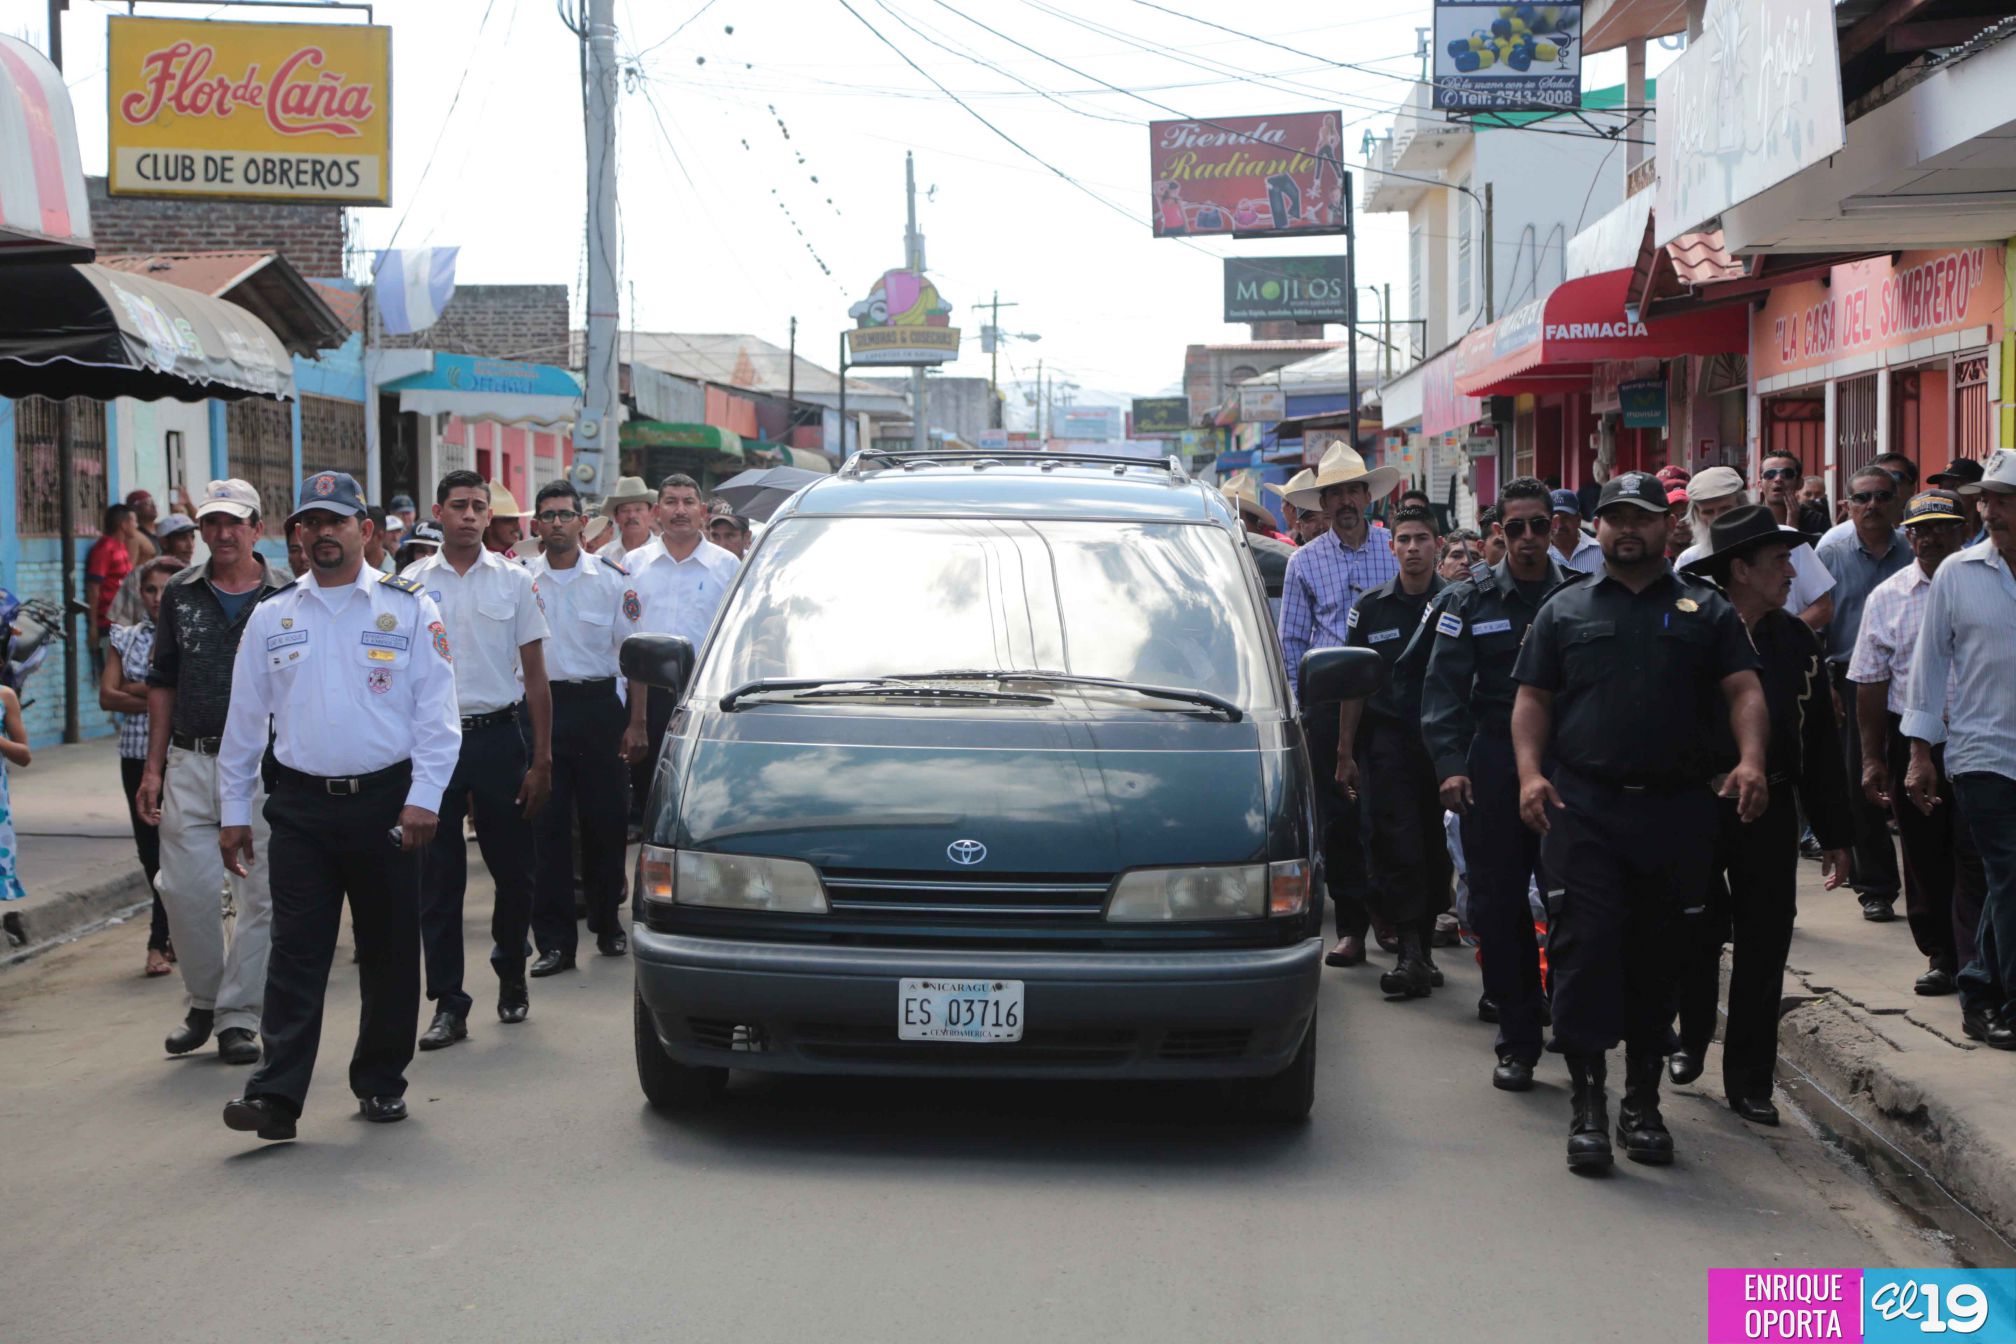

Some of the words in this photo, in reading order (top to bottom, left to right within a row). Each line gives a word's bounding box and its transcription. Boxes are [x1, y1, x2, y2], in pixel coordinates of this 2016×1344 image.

[121, 41, 233, 126] Flor
[231, 64, 264, 106] de
[265, 46, 374, 137] Caña
[1496, 89, 1574, 106] 2713-2008
[1160, 122, 1287, 149] Tienda
[136, 153, 196, 183] CLUB
[204, 155, 234, 184] DE
[244, 158, 360, 190] OBREROS
[1160, 146, 1316, 181] Radiante
[1545, 321, 1649, 340] FARMACIA
[1804, 299, 1837, 358] CASA
[1842, 288, 1872, 348] DEL
[1627, 409, 1661, 418] movistar
[928, 982, 998, 993] NICARAGUA
[905, 998, 932, 1026] ES
[948, 999, 1018, 1028] 03716
[930, 1028, 992, 1039] CENTROAMERICA
